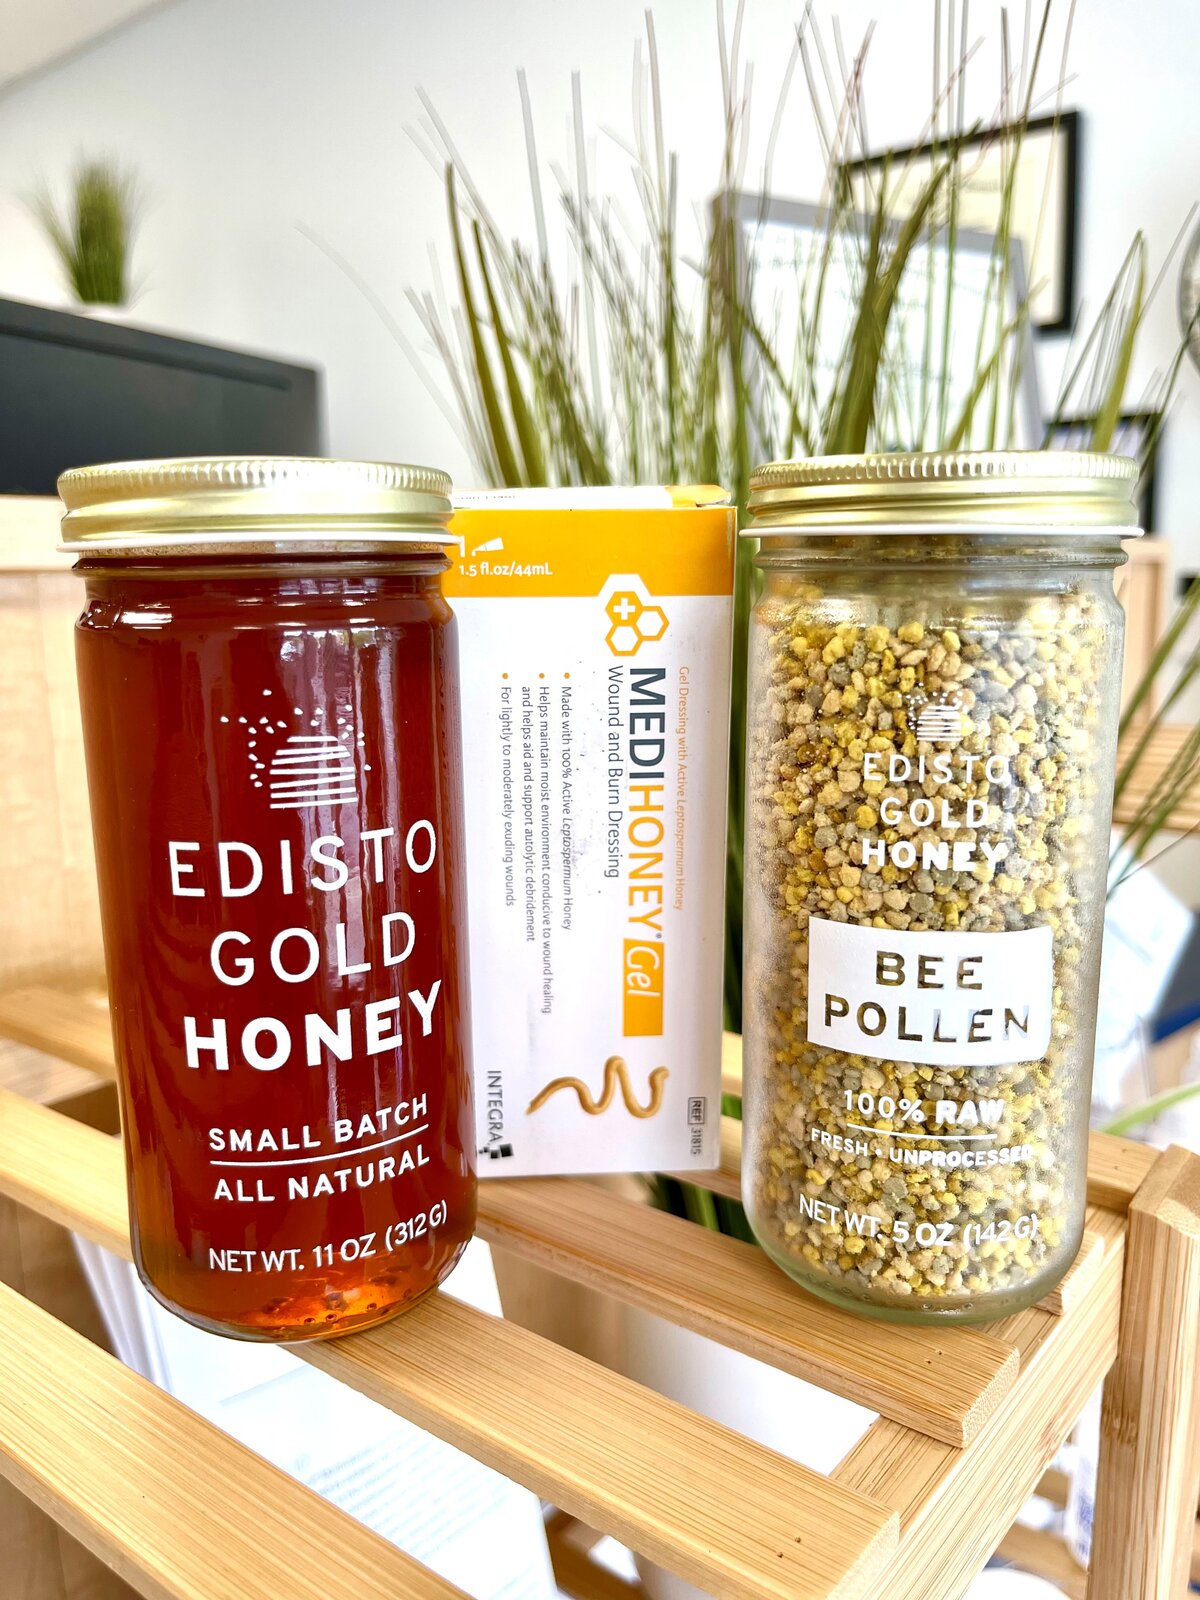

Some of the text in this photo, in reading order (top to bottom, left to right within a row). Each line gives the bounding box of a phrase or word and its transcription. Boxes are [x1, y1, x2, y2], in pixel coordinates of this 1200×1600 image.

[459, 561, 553, 577] 1.5 fl.oz/44mL
[499, 686, 517, 907] For lightly to moderately exuding wounds
[604, 665, 624, 878] Wound and Burn Dressing
[673, 666, 690, 911] Gel Dressing with Active Leptospermum Honey
[863, 752, 1011, 784] EDISTO
[520, 686, 537, 942] and helps aid and support autolytic debridement
[561, 686, 574, 930] Made with 100% Active Leptospermum Honey
[880, 796, 989, 829] GOLD
[168, 819, 437, 897] EDISTO
[537, 686, 554, 1015] Helps maintain moist environment conducive to wound healing
[862, 838, 1009, 874] HONEY
[210, 911, 416, 987] GOLD
[626, 945, 661, 996] Gel
[876, 950, 983, 991] BEE
[184, 979, 442, 1071] HONEY
[824, 993, 1030, 1043] POLLEN
[209, 1093, 427, 1152] SMALL BATCH
[487, 1070, 503, 1142] INTEGRA
[690, 1099, 703, 1156] REF 31815
[844, 1089, 1006, 1125] 100% RAW
[214, 1144, 430, 1202] ALL NATURAL
[811, 1128, 1034, 1167] FRESH UNPROCESSED
[799, 1193, 840, 1227] NET
[844, 1209, 883, 1239] WT.
[892, 1220, 910, 1243] 5
[915, 1222, 954, 1247] OZ
[209, 1248, 256, 1272] NET
[261, 1249, 305, 1272] WT.
[312, 1244, 334, 1268] 11
[340, 1232, 376, 1262] OZ
